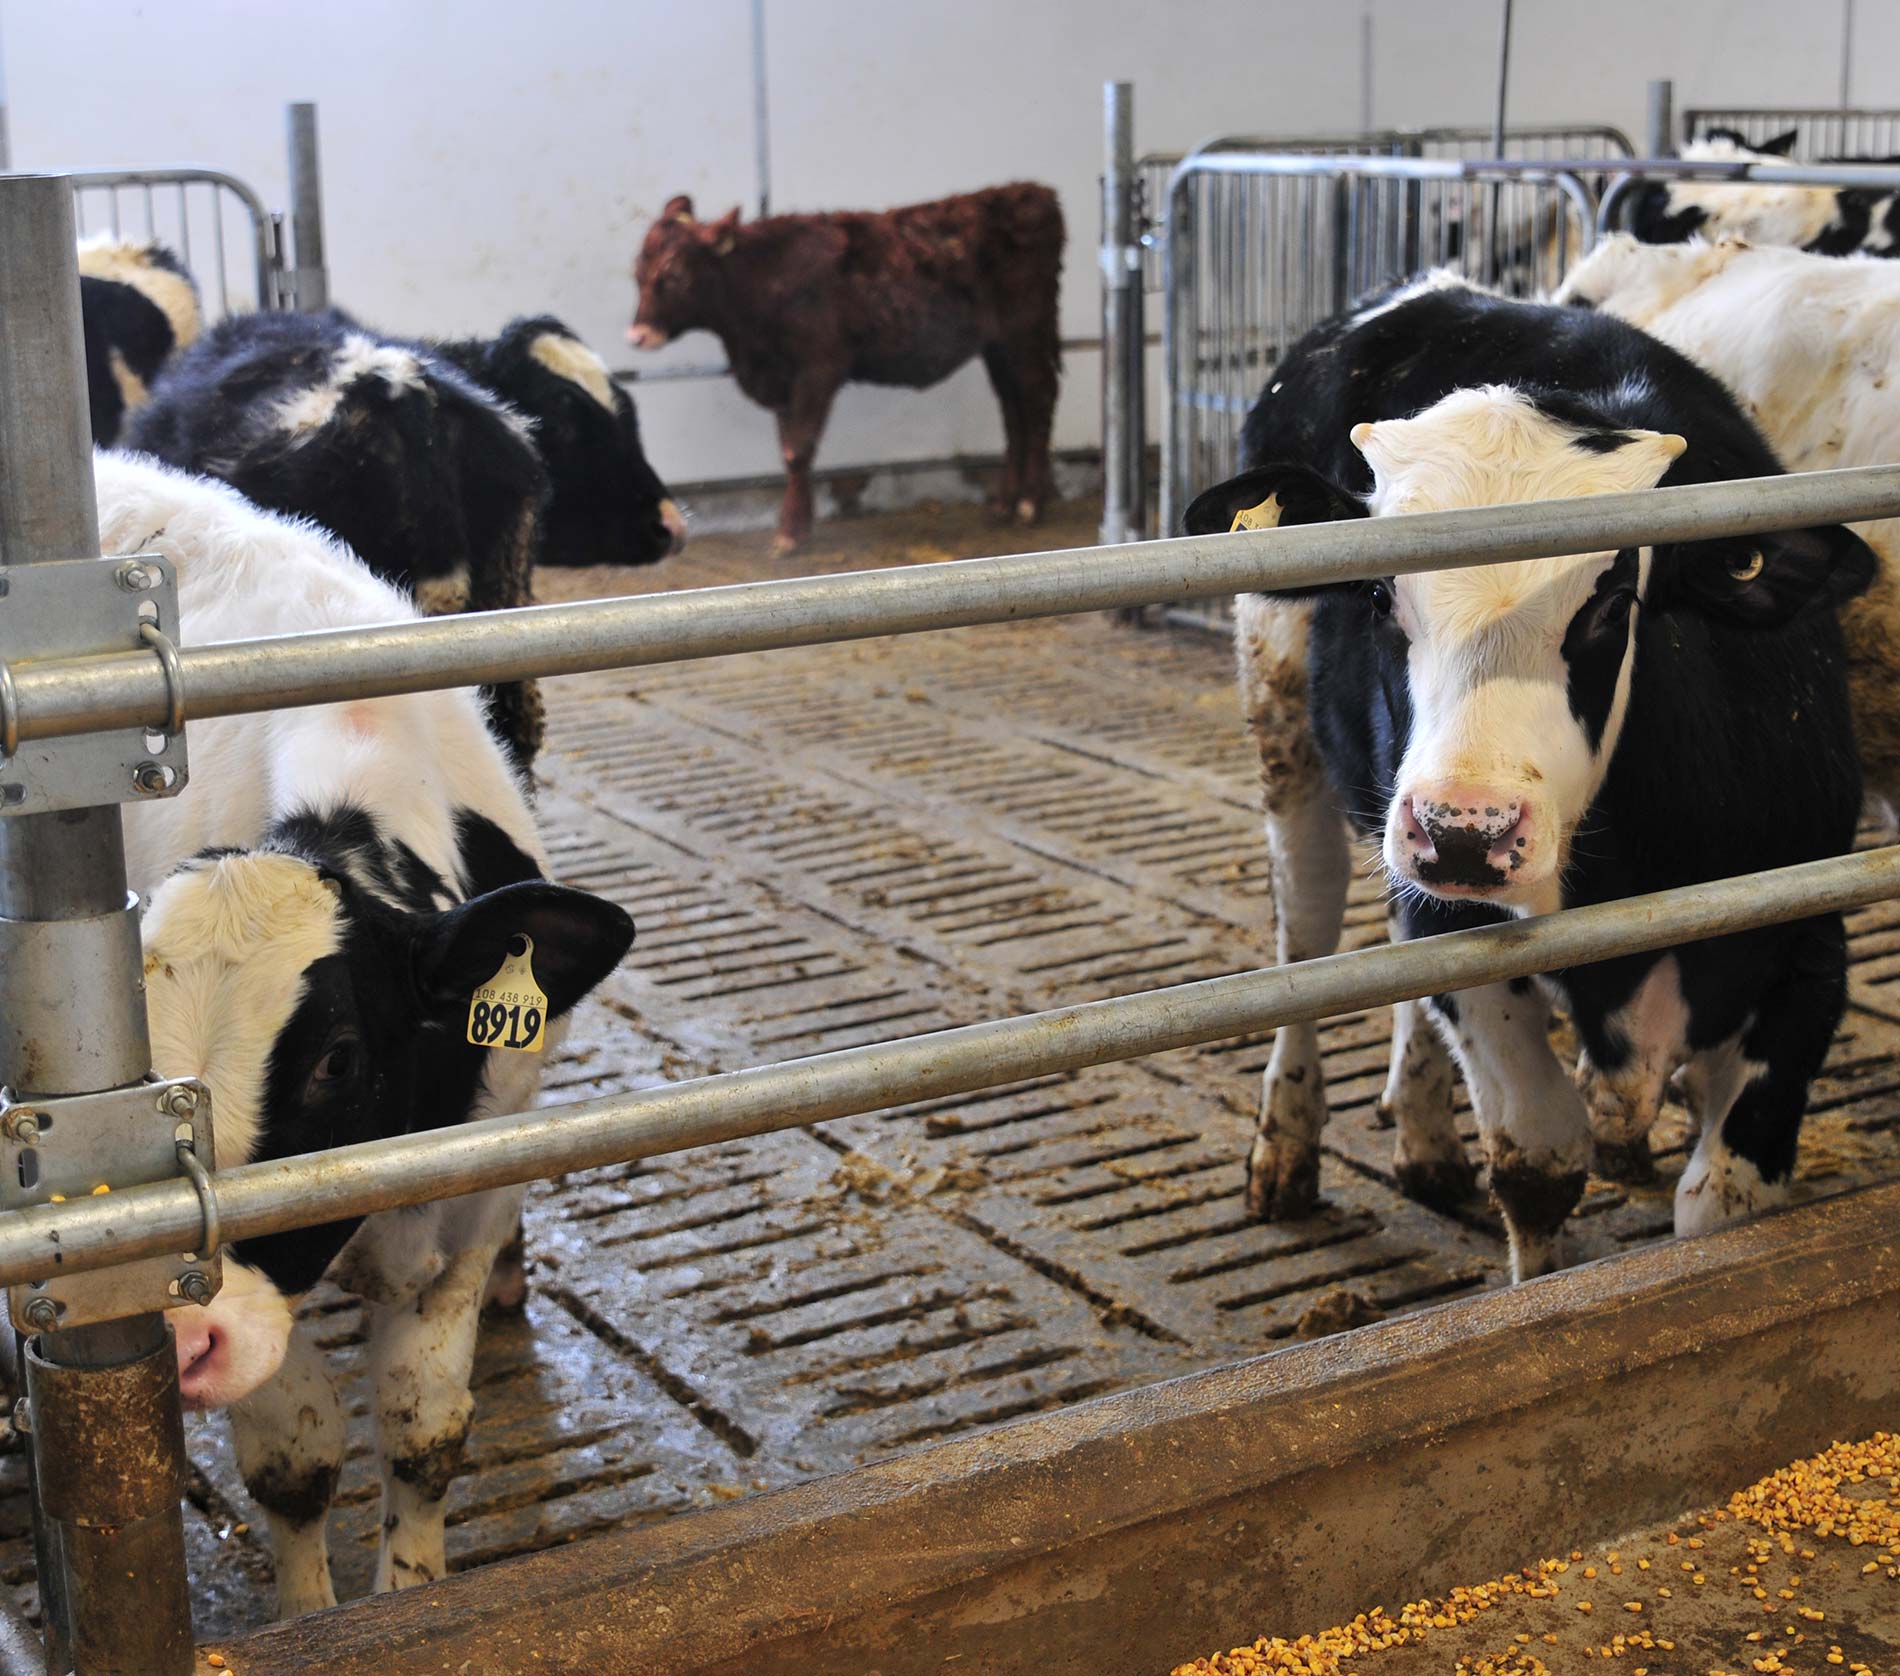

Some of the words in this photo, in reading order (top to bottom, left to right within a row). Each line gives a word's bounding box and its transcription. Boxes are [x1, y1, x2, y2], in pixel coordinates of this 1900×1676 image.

[475, 989, 496, 1000] 108
[500, 992, 519, 1003] 438
[523, 995, 543, 1006] 919
[472, 1001, 541, 1048] 8919
